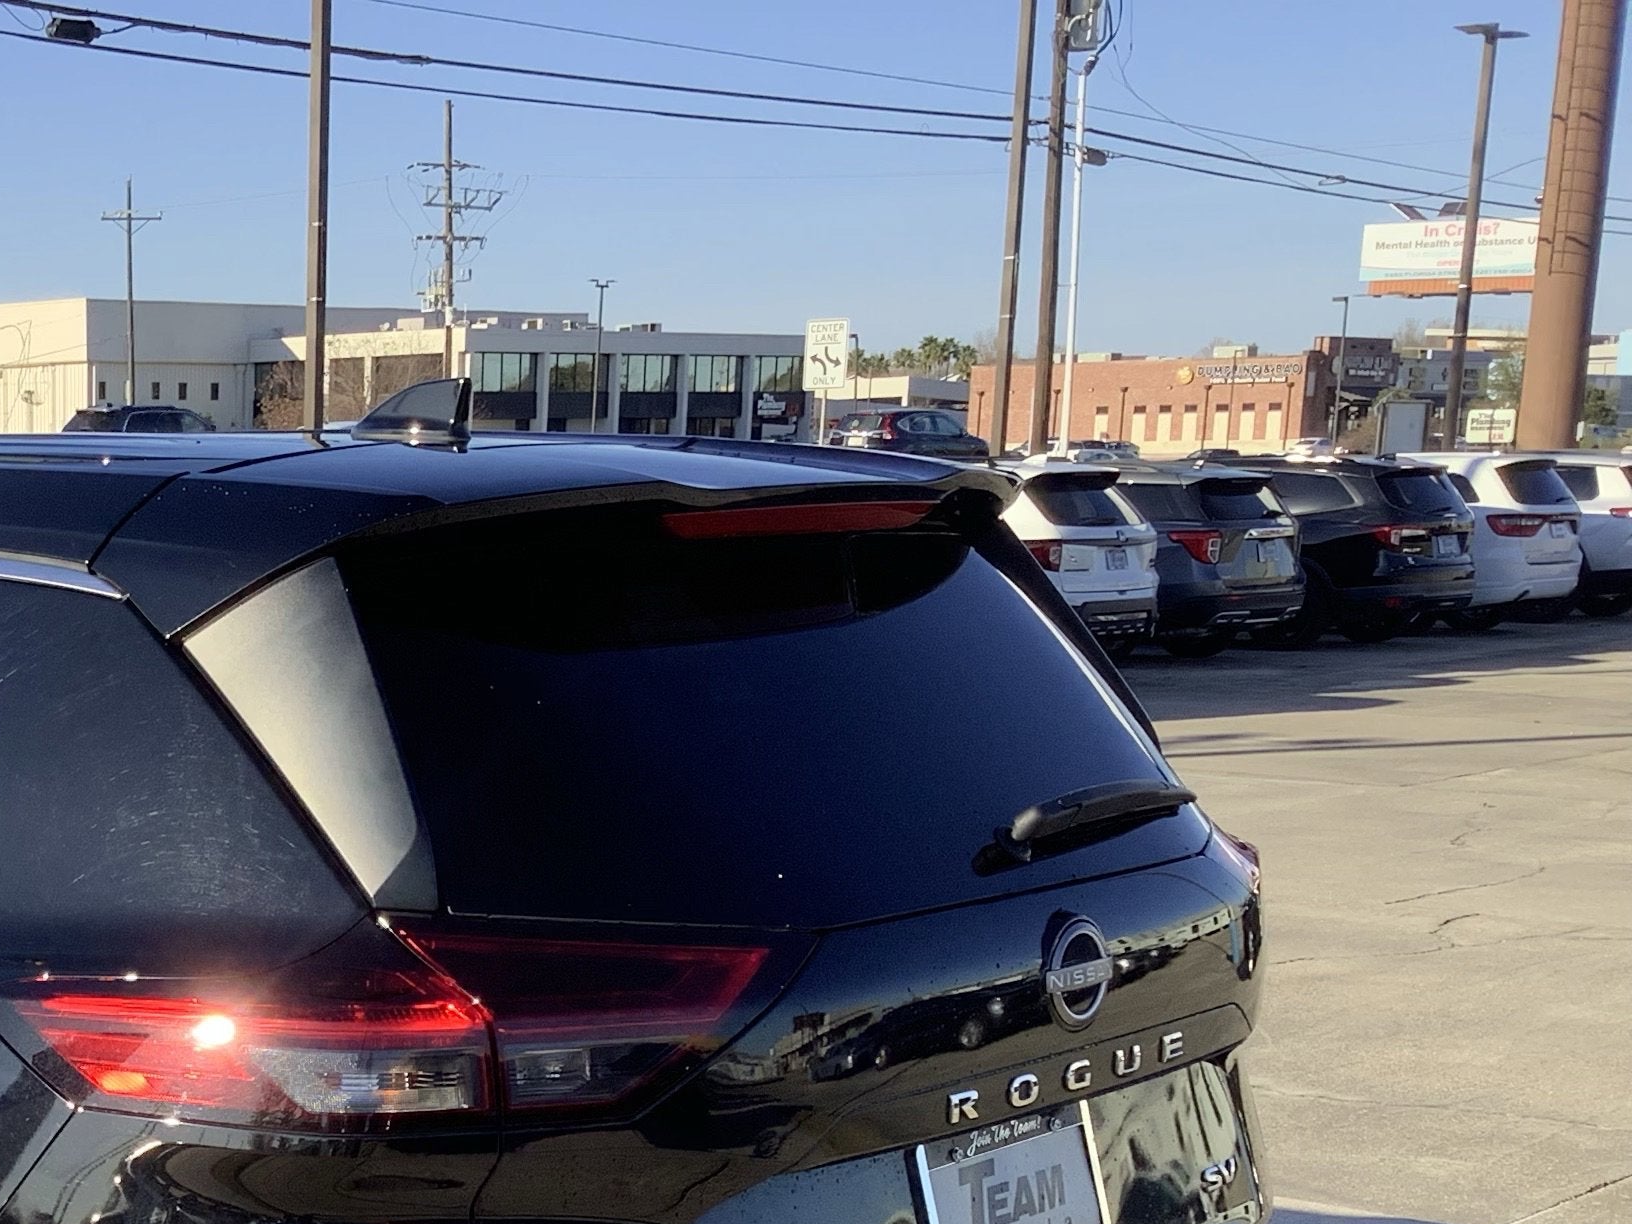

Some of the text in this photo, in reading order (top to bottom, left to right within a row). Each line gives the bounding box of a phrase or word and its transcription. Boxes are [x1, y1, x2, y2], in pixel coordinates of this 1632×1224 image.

[1424, 223, 1500, 237] In Cris?
[1375, 239, 1412, 250] Mental
[1415, 238, 1450, 248] Health
[1475, 237, 1524, 247] ubstance
[810, 322, 845, 333] CENTER
[815, 333, 839, 343] LANE
[1197, 364, 1261, 377] DUMPING
[1275, 363, 1304, 374] BAO
[813, 376, 836, 386] ONLY
[948, 1031, 1183, 1124] ROGUE
[967, 1130, 991, 1156] Join
[991, 1123, 1011, 1143] The
[1204, 1157, 1236, 1191] SV
